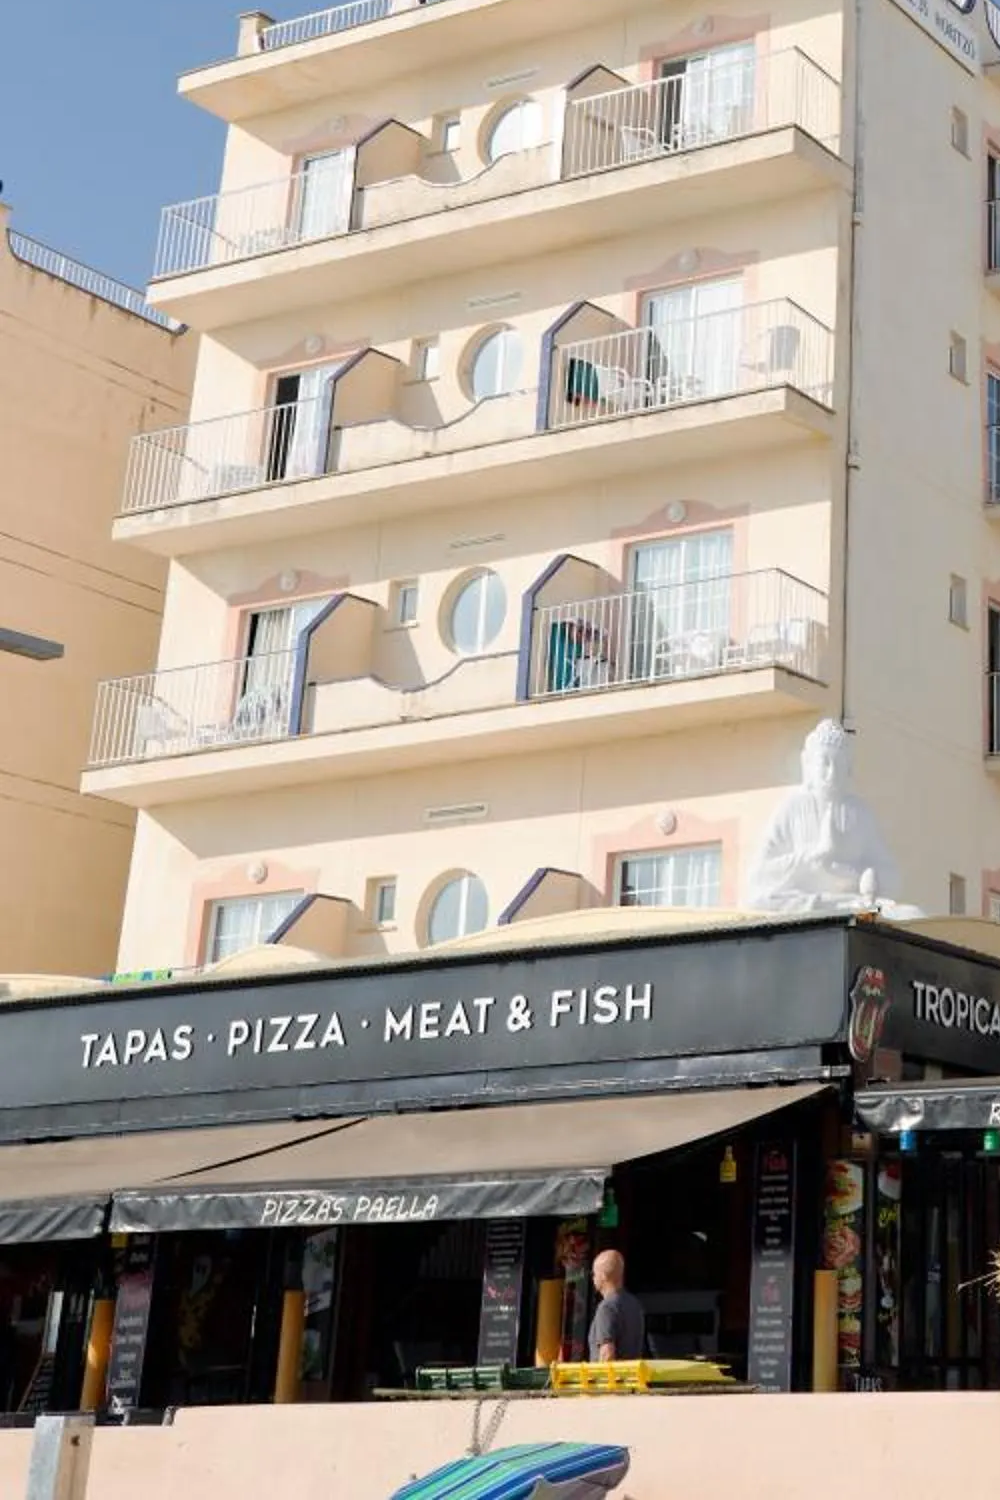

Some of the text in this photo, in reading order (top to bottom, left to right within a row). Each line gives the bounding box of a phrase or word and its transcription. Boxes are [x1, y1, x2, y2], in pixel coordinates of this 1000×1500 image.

[80, 982, 653, 1068] TAPAS PIZZA MEAT & FISH
[352, 1193, 440, 1222] PAELLA
